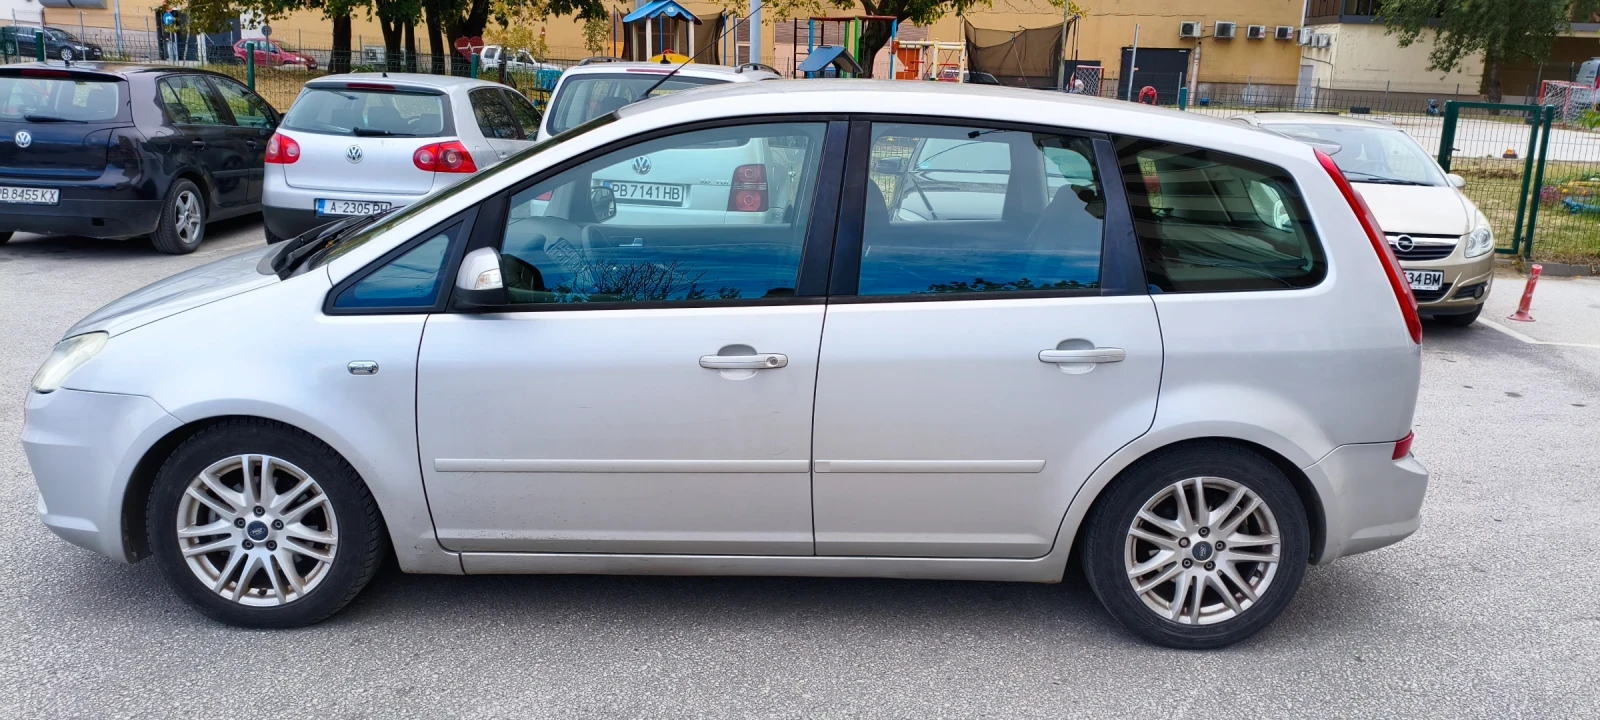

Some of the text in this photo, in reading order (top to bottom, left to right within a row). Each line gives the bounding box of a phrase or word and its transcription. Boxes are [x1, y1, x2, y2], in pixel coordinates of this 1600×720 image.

[0, 188, 57, 201] B 8455 KX
[612, 184, 680, 200] PB 7141 HB
[1404, 272, 1441, 286] 34 BM
